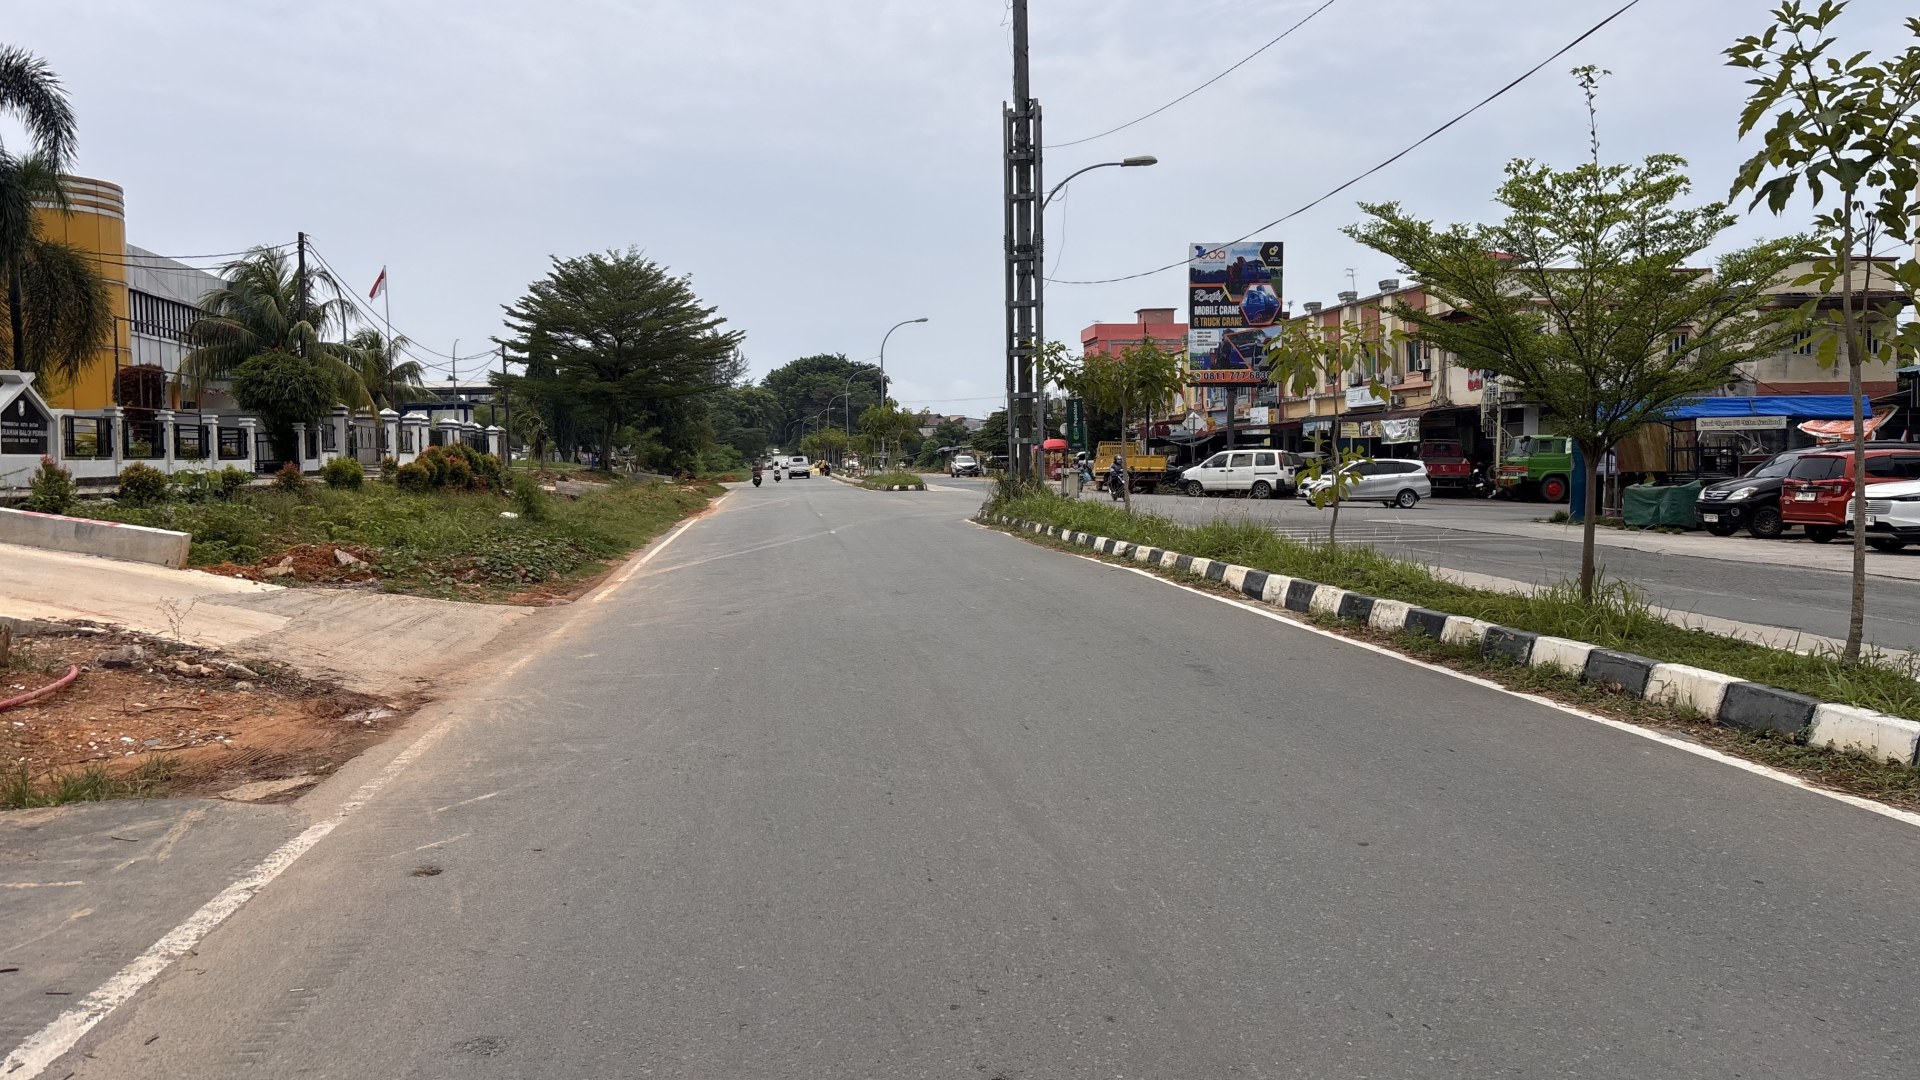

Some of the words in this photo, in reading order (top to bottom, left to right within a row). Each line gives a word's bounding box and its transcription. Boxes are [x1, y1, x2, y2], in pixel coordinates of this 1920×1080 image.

[1219, 305, 1240, 316] CRANE
[1200, 317, 1221, 327] TRUCK
[1222, 317, 1242, 327] CRANE
[1203, 371, 1226, 380] 0811
[1230, 371, 1246, 380] 777
